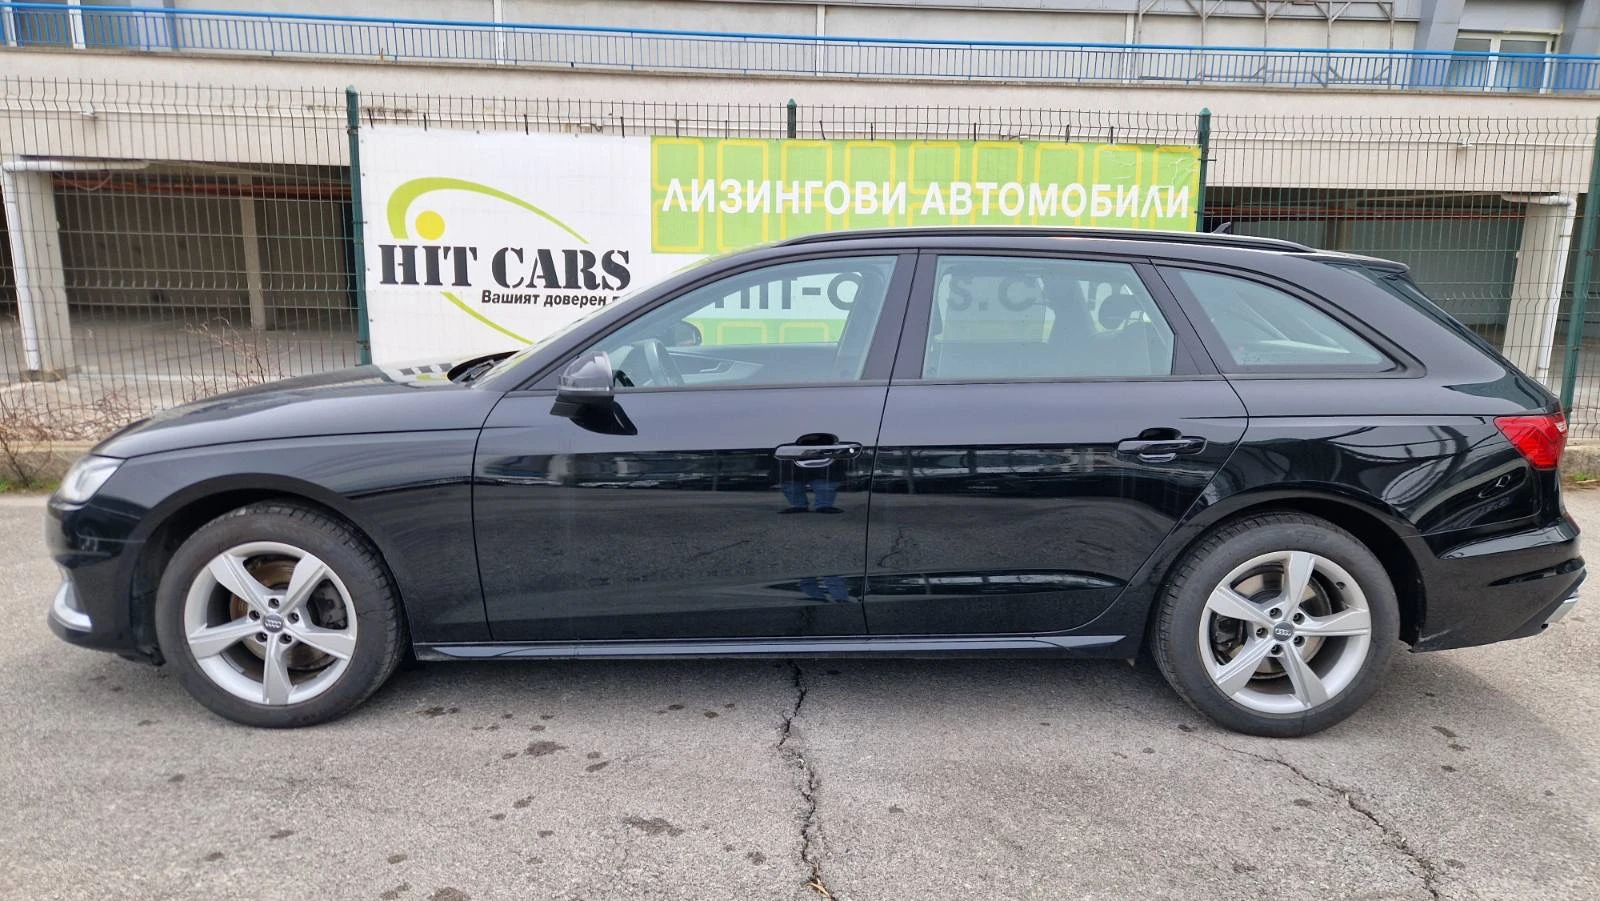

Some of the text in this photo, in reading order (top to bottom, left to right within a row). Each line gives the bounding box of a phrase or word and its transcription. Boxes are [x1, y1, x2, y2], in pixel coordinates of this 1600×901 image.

[662, 178, 1189, 218] ЛИЗИНГОВИ АВТОМОБИЛИ
[378, 244, 631, 291] HIT CARS
[481, 290, 540, 305] Вашият
[543, 294, 607, 309] доверен
